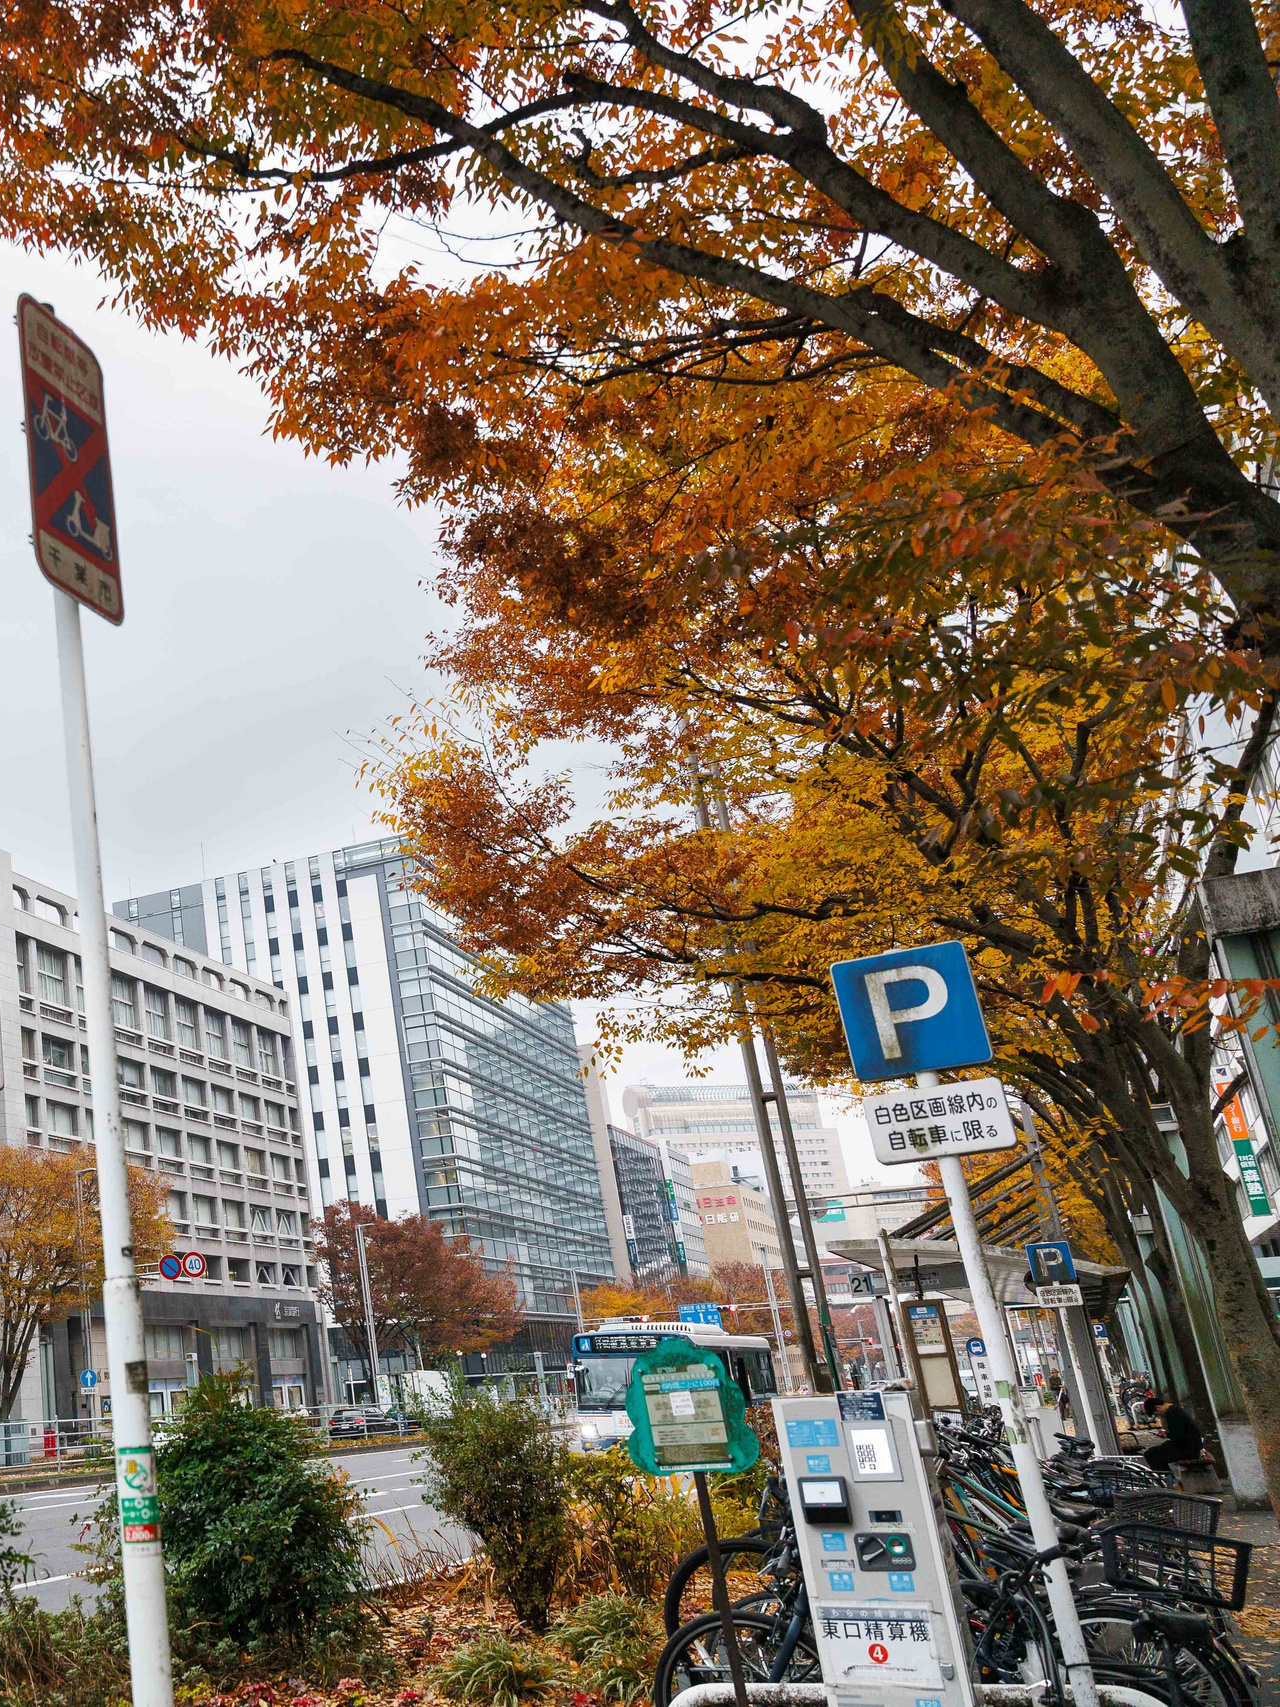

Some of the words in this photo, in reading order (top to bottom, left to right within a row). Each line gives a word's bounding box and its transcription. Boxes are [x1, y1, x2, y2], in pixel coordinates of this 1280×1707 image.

[48, 545, 112, 602] 千葉市
[864, 965, 948, 1060] P
[874, 1091, 998, 1126] 白色区画線内の
[888, 1119, 999, 1151] 自転車に限る
[188, 1258, 201, 1271] 40
[1036, 1248, 1063, 1277] P
[851, 1276, 870, 1293] 21
[1093, 1325, 1103, 1336] P
[821, 1620, 931, 1642] 東口精算機
[873, 1646, 884, 1660] 4
